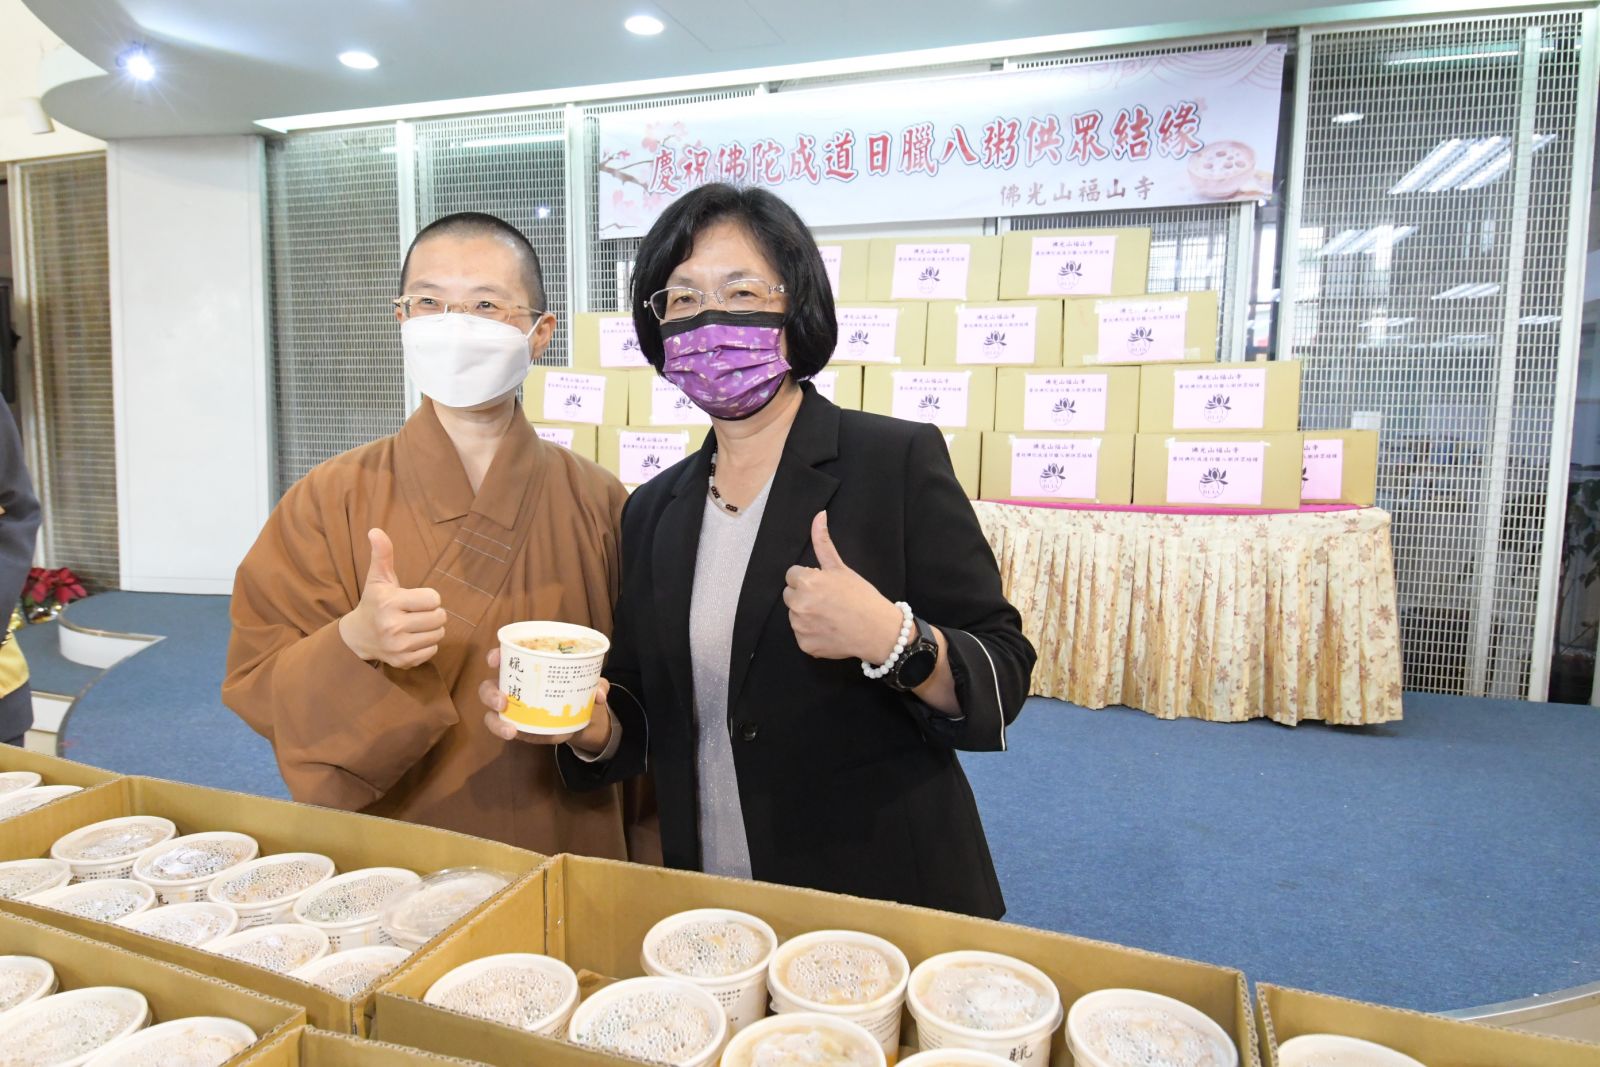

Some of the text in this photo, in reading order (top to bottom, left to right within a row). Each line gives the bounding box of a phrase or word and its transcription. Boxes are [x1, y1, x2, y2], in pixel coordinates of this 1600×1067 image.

[648, 102, 1202, 194] 慶祝佛陀成道日臘八粥供眾結緣
[1000, 175, 1155, 208] 佛光山福山寺
